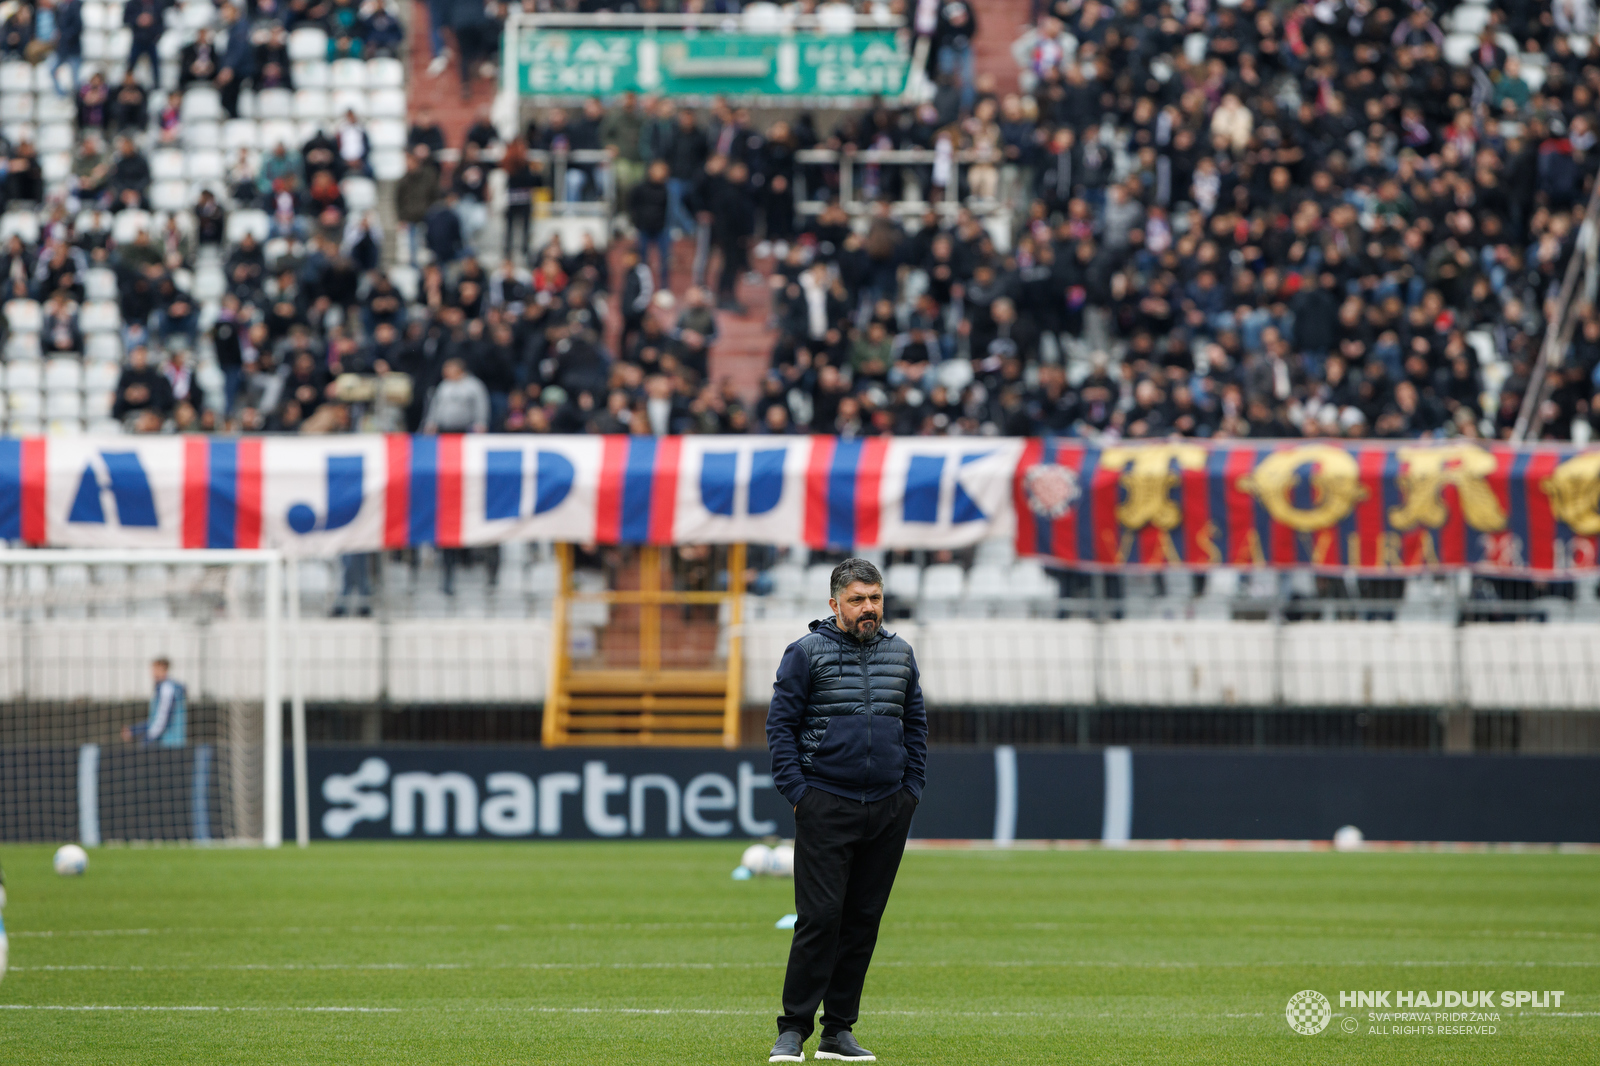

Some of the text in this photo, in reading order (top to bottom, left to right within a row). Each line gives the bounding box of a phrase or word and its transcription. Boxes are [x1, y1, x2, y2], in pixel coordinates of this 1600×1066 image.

[527, 65, 617, 92] EXIT
[817, 65, 905, 93] EXIT
[322, 757, 777, 837] smartnet
